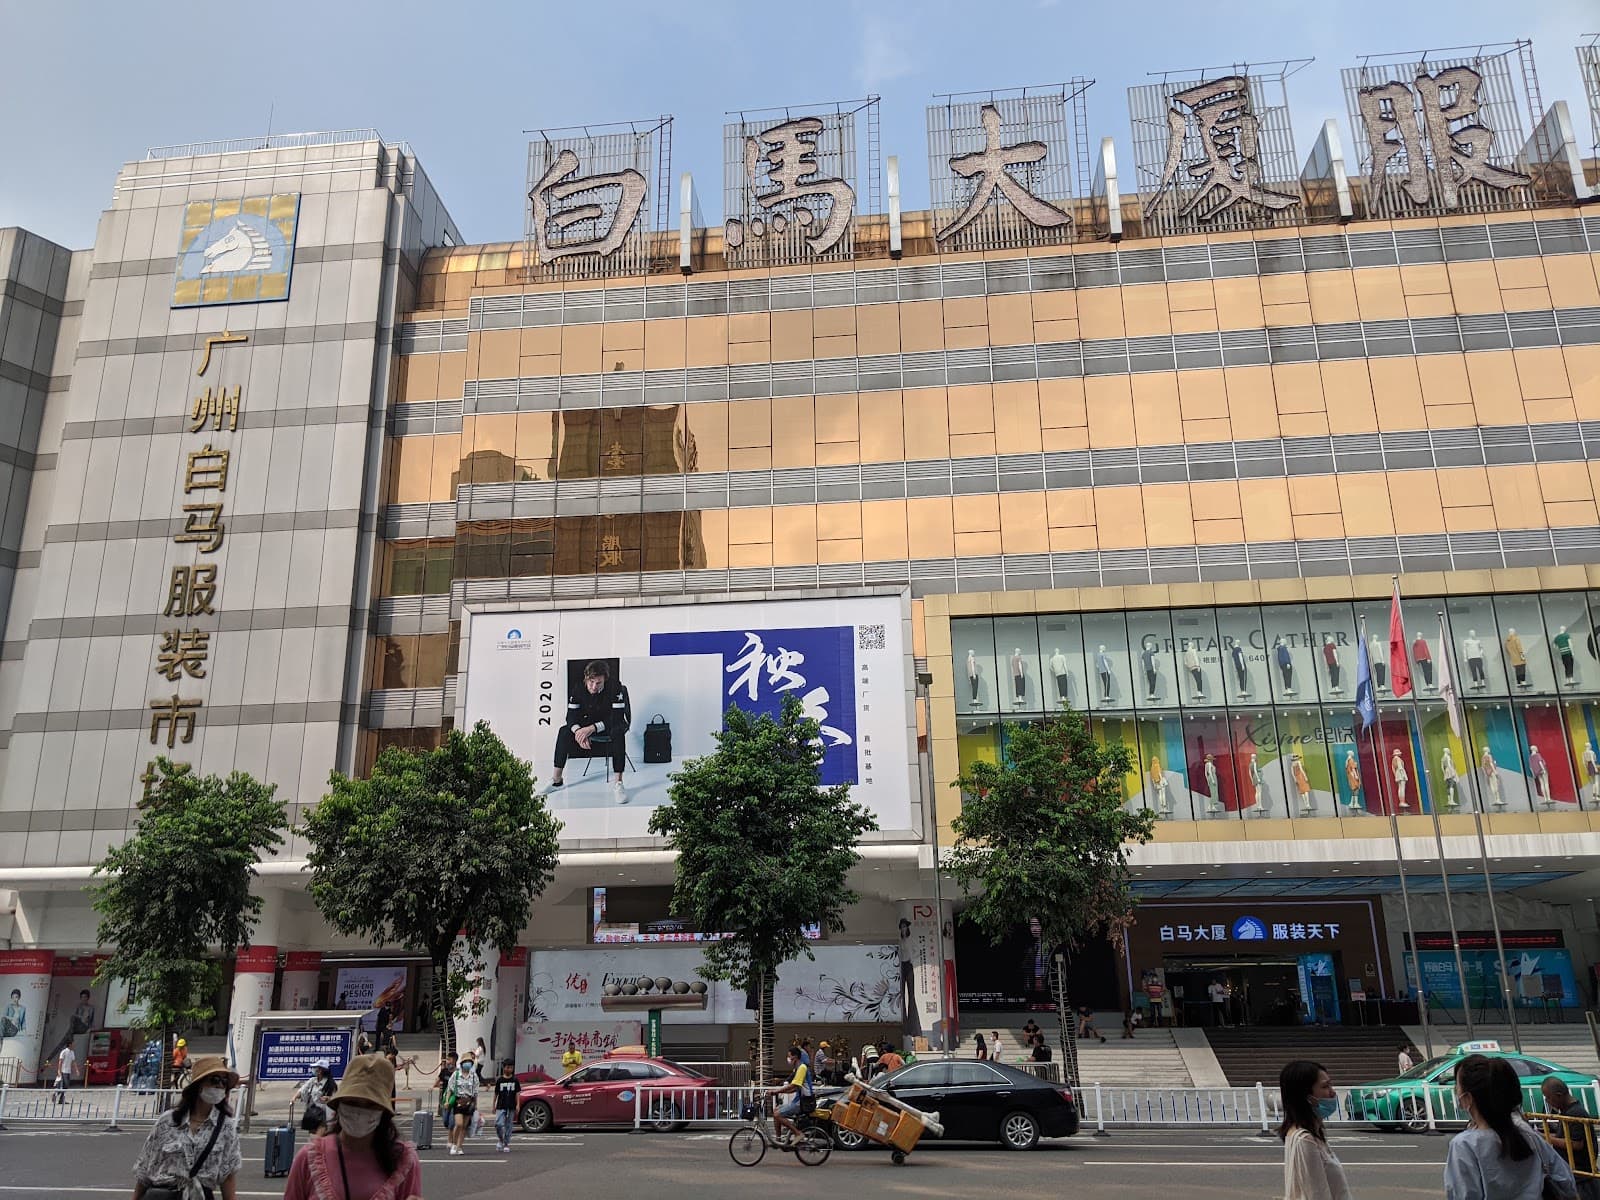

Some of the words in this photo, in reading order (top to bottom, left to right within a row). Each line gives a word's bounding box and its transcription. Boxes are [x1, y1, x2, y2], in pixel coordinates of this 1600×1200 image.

[541, 633, 555, 671] NEW
[538, 680, 553, 726] 2020
[1159, 924, 1228, 942] 白马大厦
[1272, 923, 1340, 940] 服装天下
[344, 990, 374, 998] DESIGN
